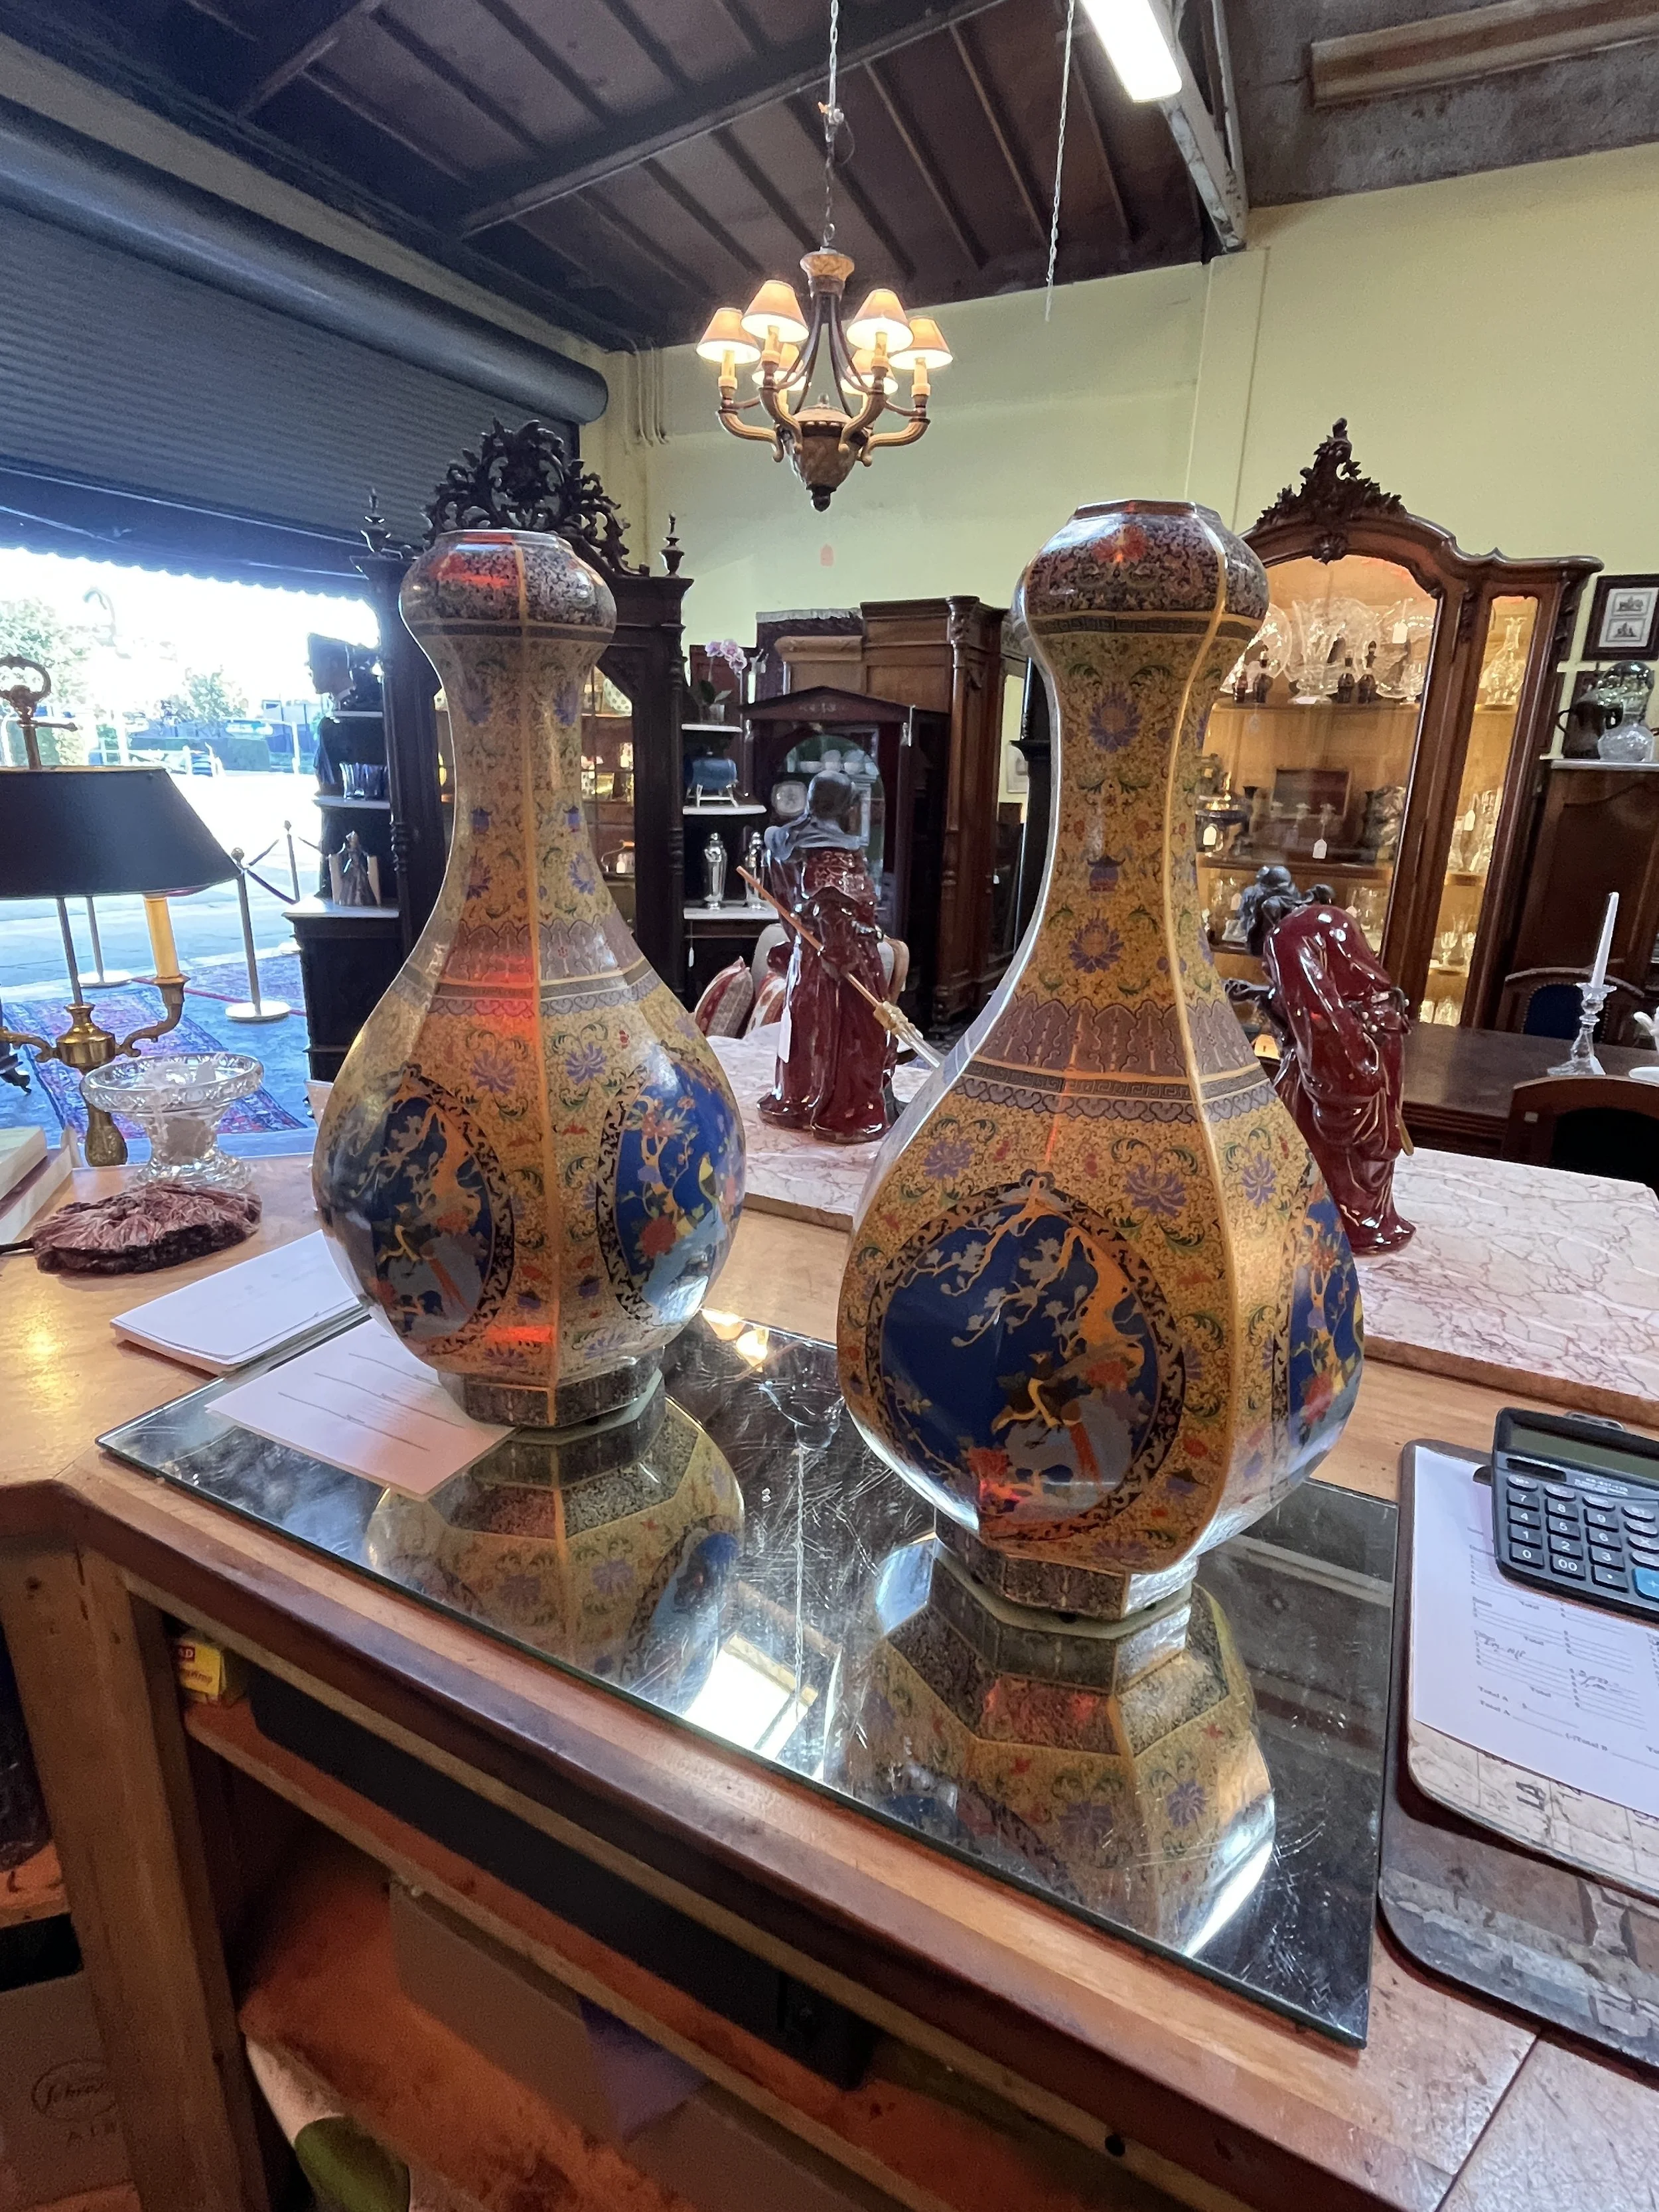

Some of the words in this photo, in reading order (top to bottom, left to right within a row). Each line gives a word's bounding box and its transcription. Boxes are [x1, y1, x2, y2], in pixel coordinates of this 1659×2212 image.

[1517, 1493, 1528, 1503] 7
[1557, 1503, 1567, 1513] 8
[1596, 1514, 1607, 1524] 9
[1520, 1512, 1529, 1521] 4
[1558, 1521, 1568, 1531] 5
[1599, 1532, 1609, 1542] 6
[1522, 1530, 1530, 1540] 1
[1561, 1540, 1571, 1552] 2
[1601, 1551, 1612, 1562] 3
[1522, 1549, 1532, 1560] 0
[1557, 1558, 1578, 1572] 00
